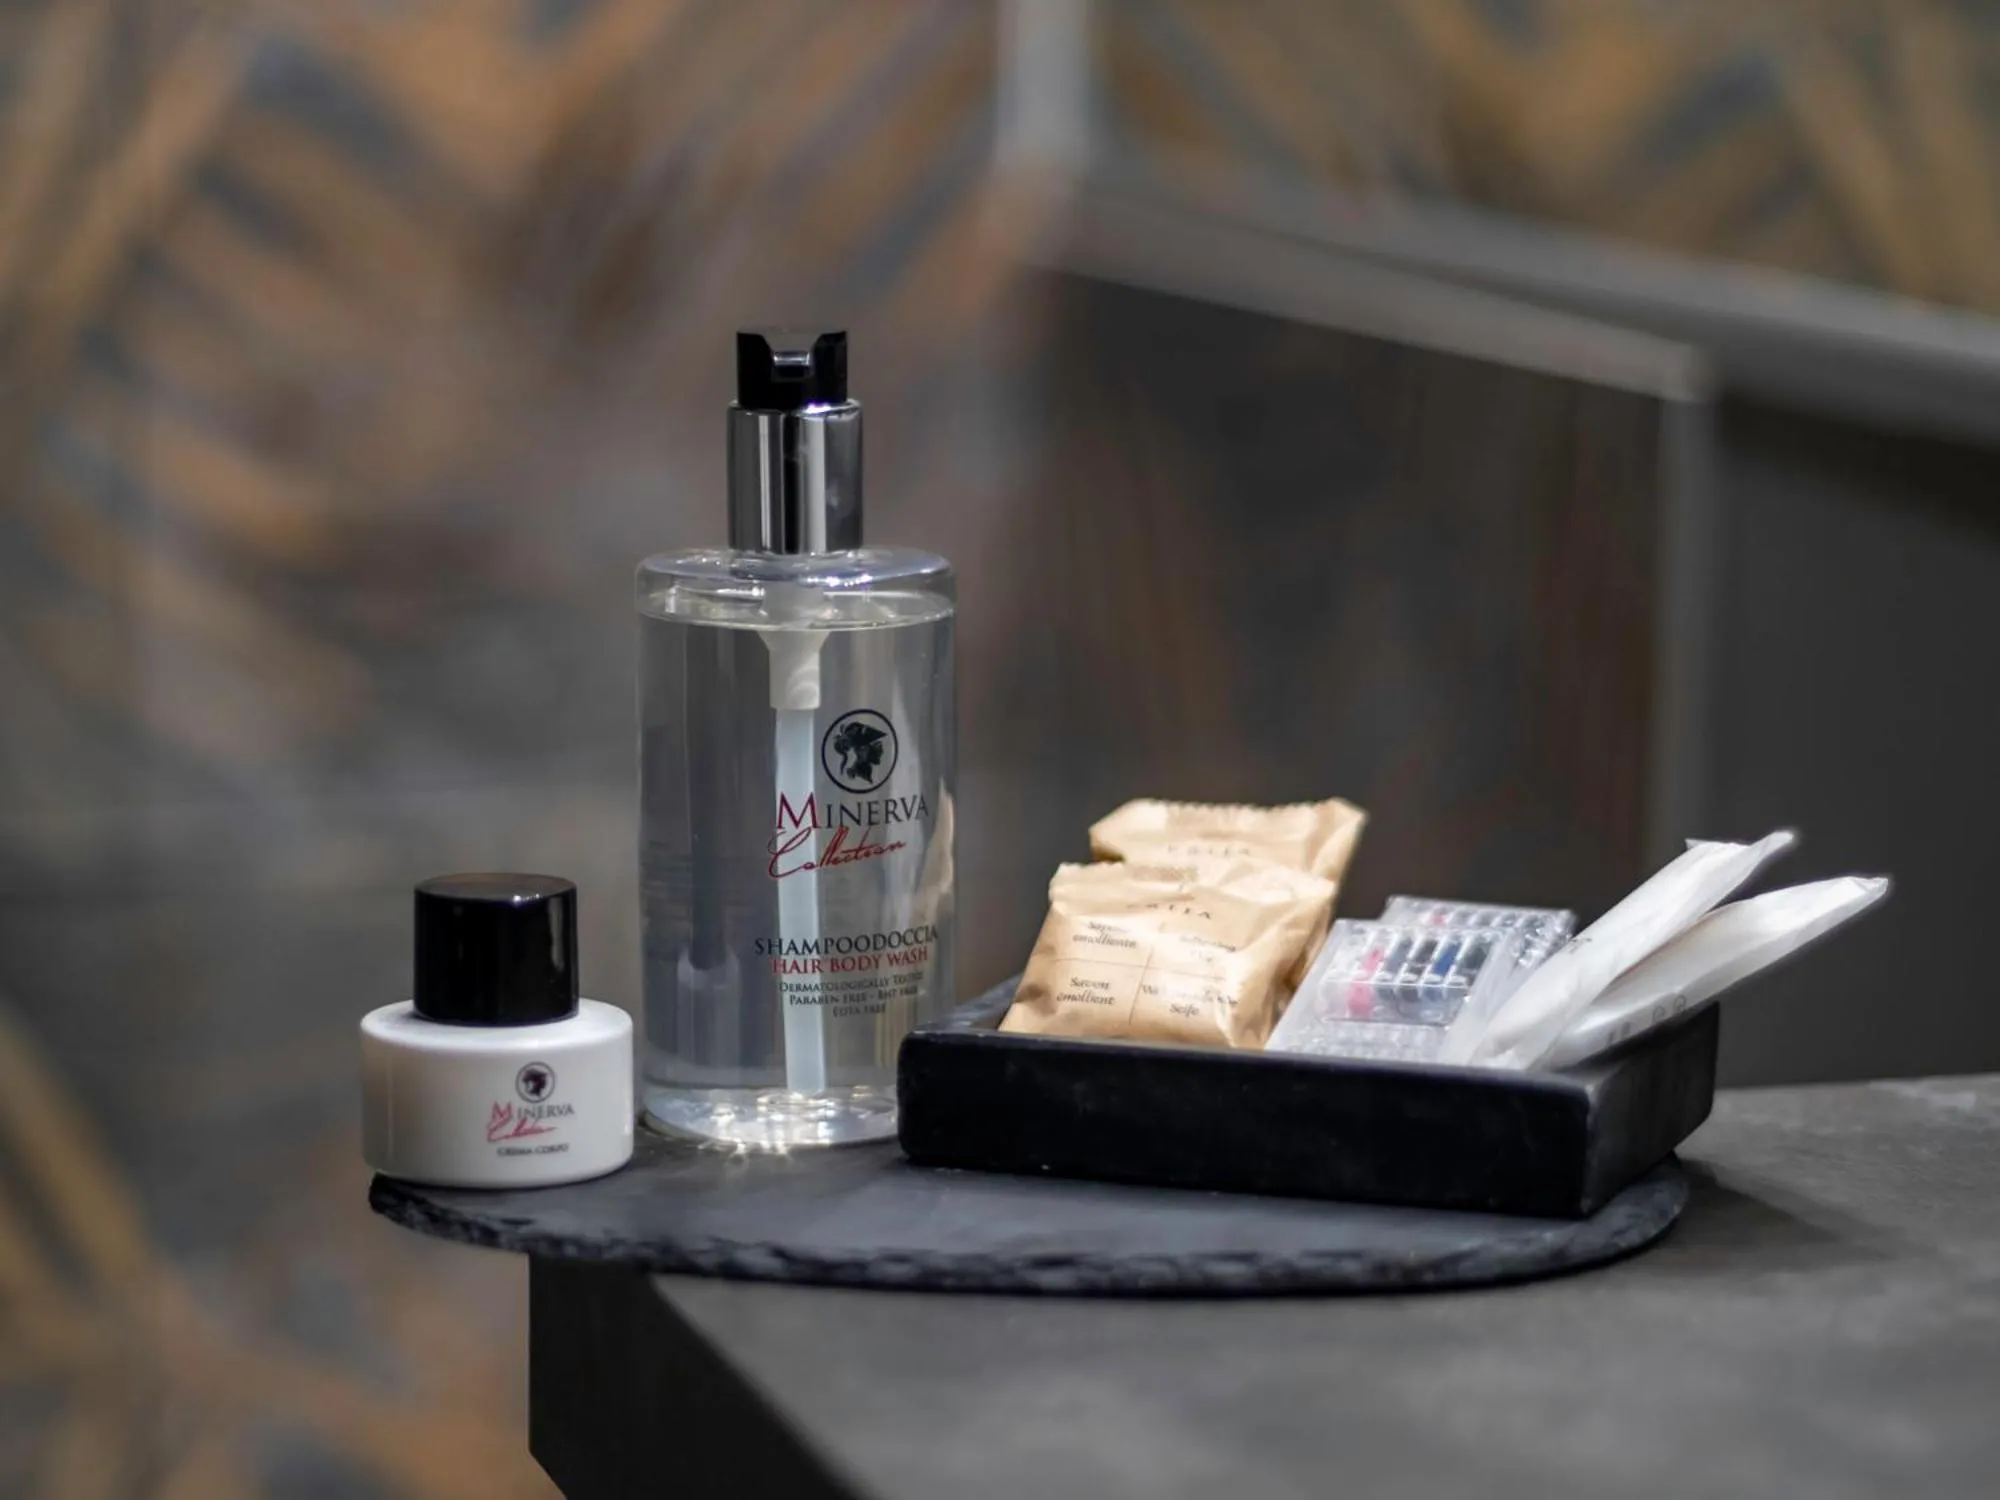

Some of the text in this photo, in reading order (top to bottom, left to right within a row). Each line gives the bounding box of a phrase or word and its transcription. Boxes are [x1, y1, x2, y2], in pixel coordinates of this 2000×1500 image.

[777, 791, 929, 829] MINERVA
[768, 826, 907, 878] Collection
[754, 924, 939, 956] SHAMPOODOCCIA
[772, 946, 929, 974] HAIR BODY WASH
